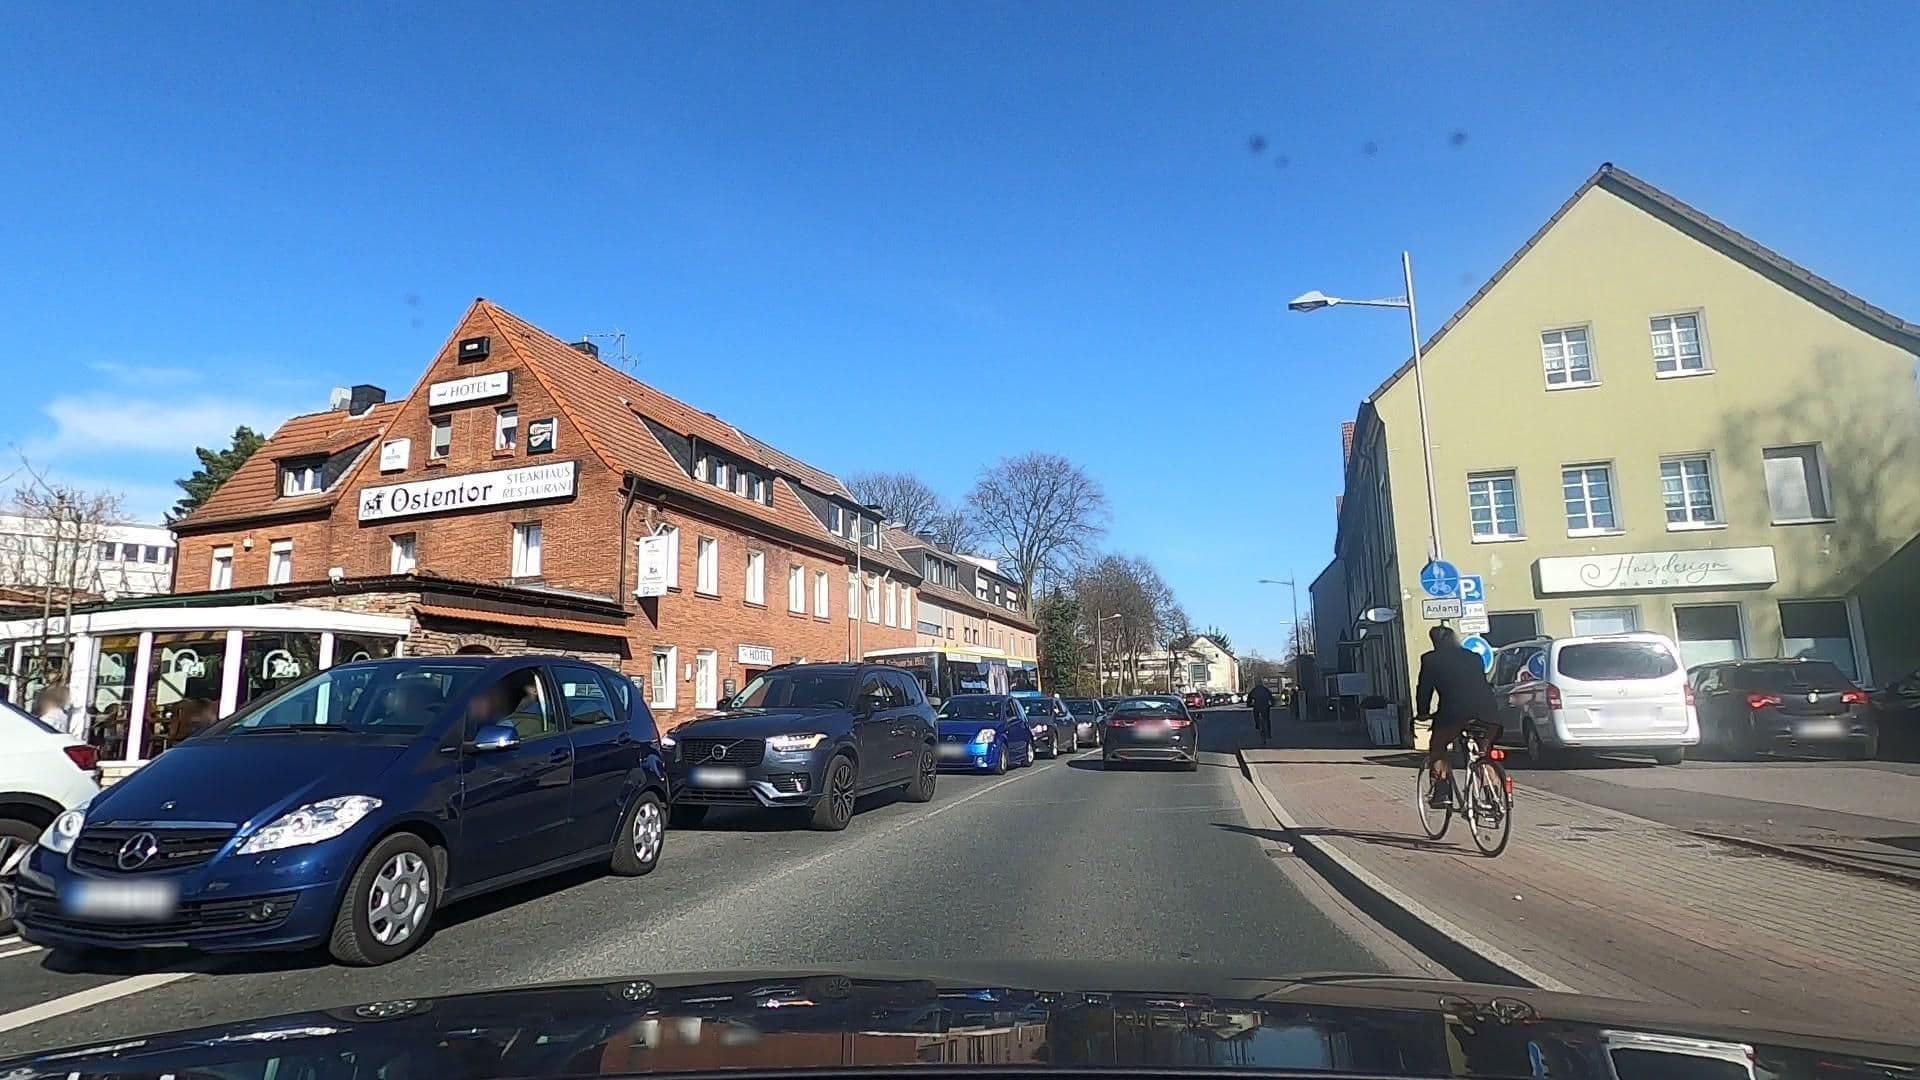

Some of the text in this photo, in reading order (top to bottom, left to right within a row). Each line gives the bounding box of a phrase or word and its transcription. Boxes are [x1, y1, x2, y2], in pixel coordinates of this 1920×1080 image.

[450, 381, 488, 397] HOTEL
[506, 467, 571, 485] STEAKHAUS
[502, 479, 573, 498] RESTAURANT
[390, 484, 493, 513] Ostentor
[1460, 578, 1477, 600] P
[1426, 604, 1460, 614] Anfang
[749, 648, 771, 662] HOTEL
